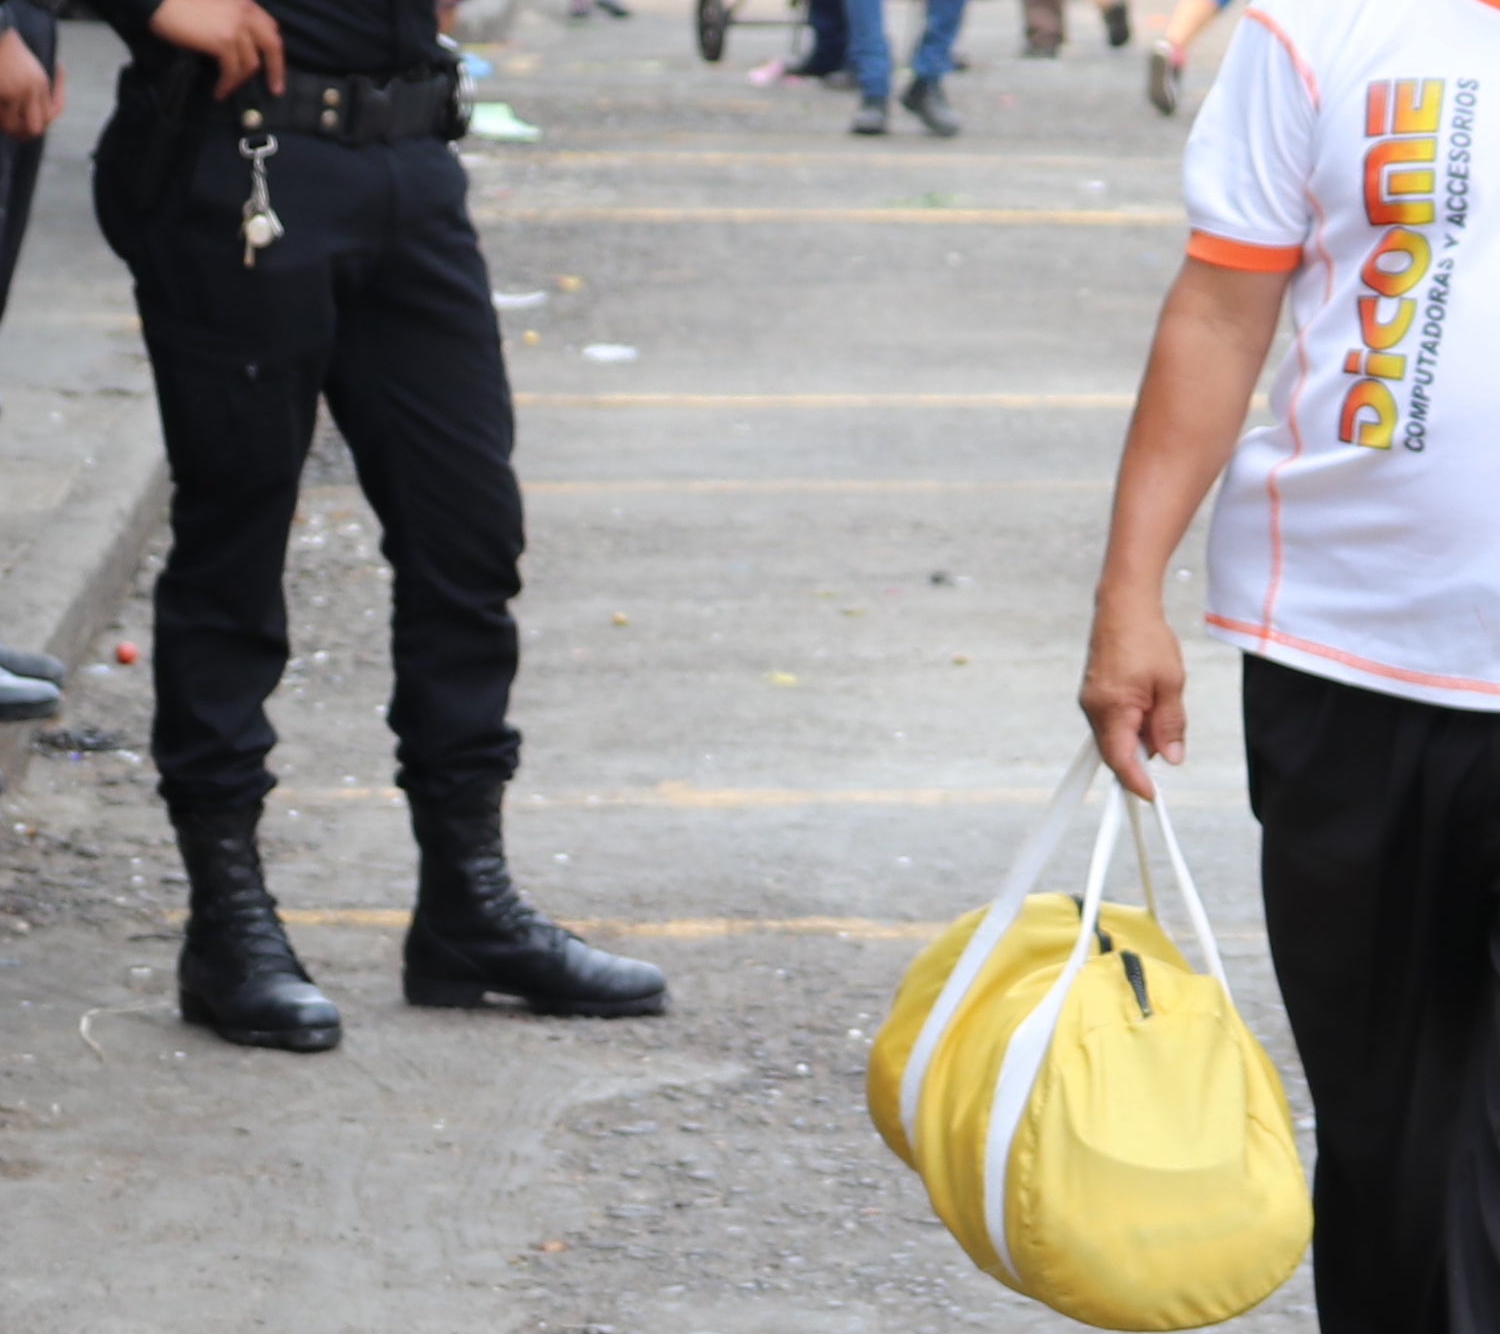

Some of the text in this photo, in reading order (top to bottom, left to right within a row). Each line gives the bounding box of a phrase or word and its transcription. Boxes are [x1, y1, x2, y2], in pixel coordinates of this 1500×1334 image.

[1404, 77, 1479, 454] COMPUTADORAS Y ACCESORIOS
